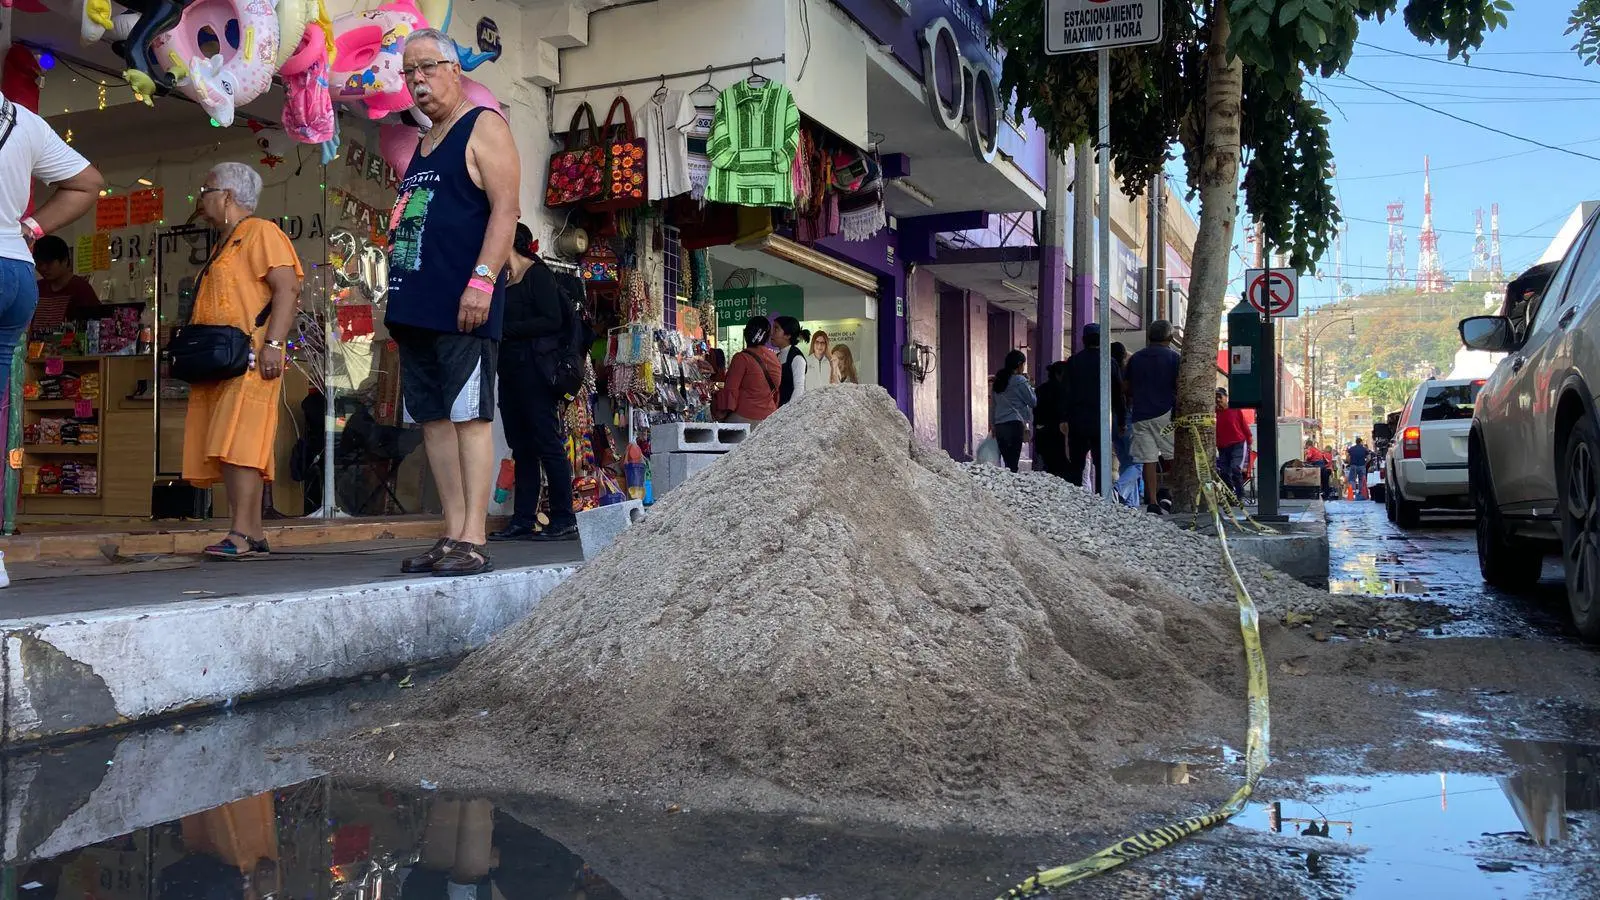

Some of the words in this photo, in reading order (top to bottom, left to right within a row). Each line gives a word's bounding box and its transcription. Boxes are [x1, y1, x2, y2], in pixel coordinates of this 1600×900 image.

[1063, 3, 1144, 28] ESTACIONAMIENTO
[481, 28, 497, 46] ADT
[1063, 26, 1103, 45] MAXIMO
[1105, 26, 1112, 40] 1
[1114, 21, 1142, 39] HORA
